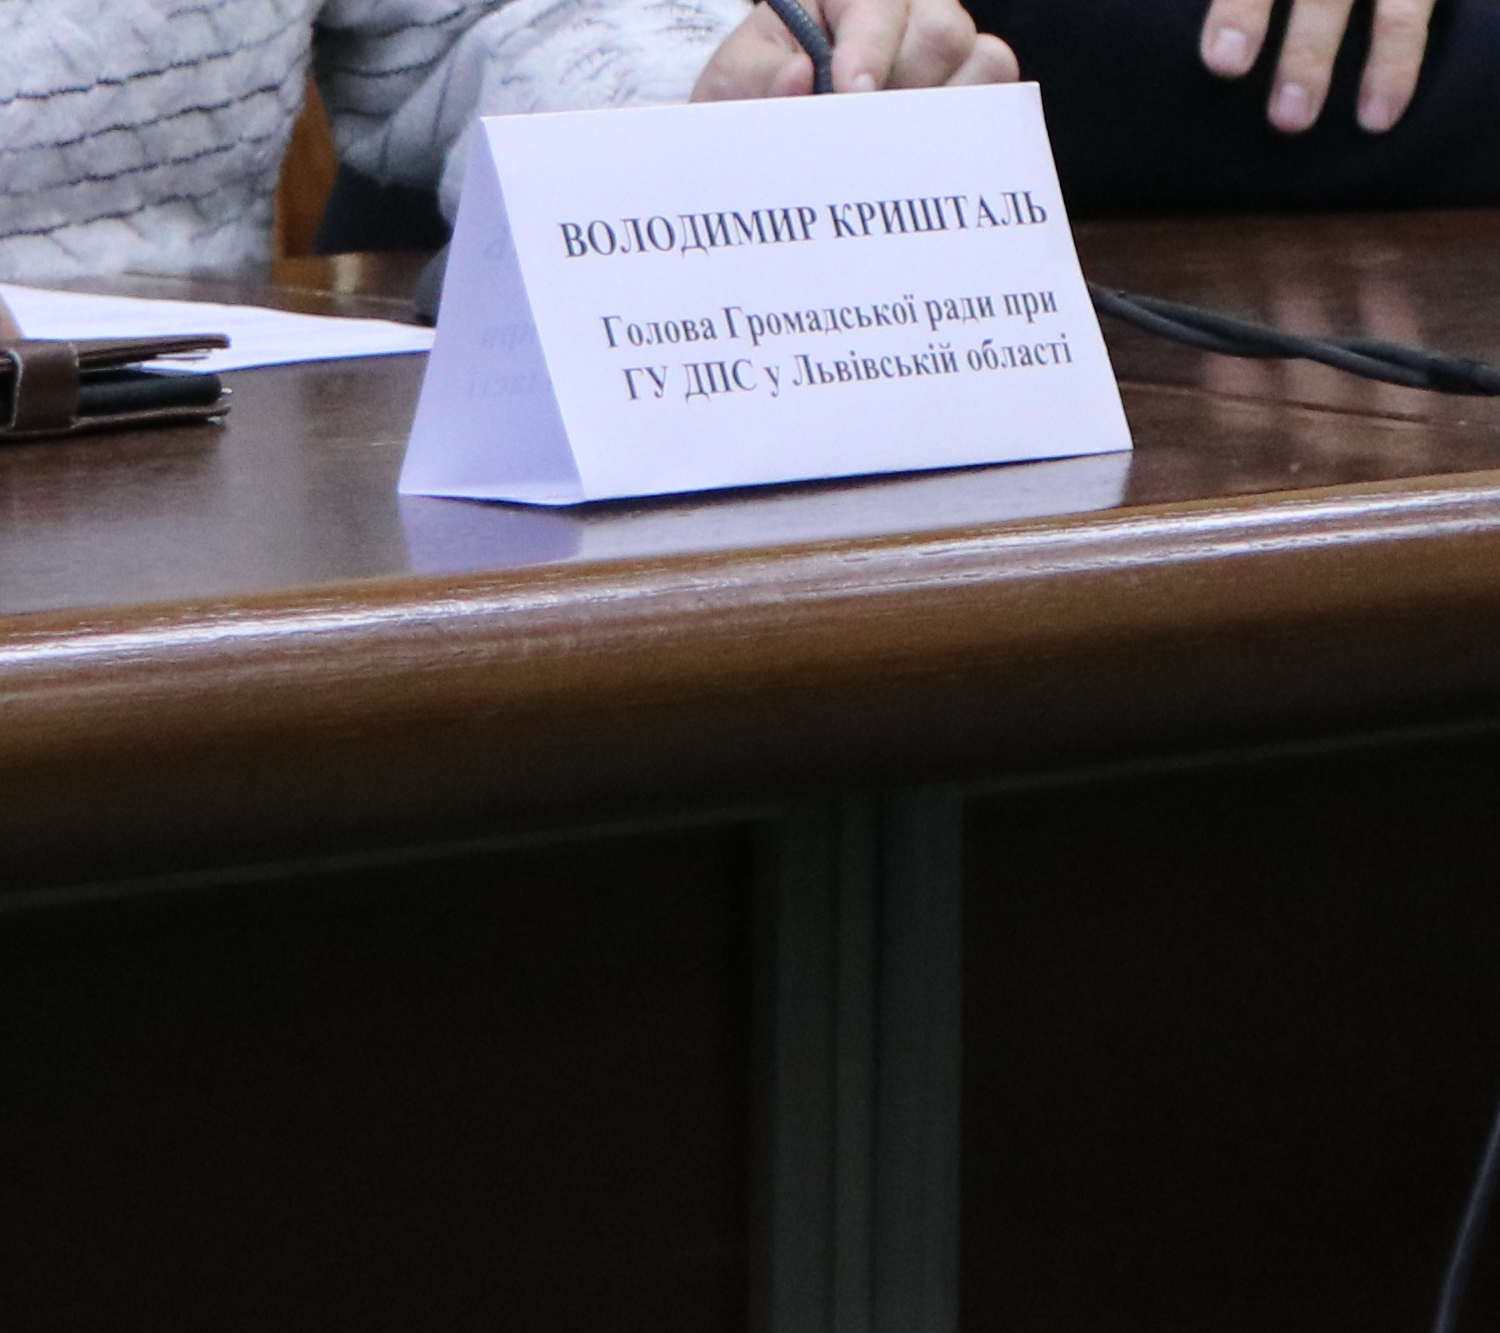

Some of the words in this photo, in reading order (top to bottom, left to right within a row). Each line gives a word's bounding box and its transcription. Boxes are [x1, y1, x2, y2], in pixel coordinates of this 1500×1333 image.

[560, 207, 817, 258] ВОЛОДИМИР
[829, 191, 1048, 239] КРИШТАЛЬ
[601, 315, 717, 349] Голова
[723, 297, 920, 346] Громадської
[925, 295, 996, 332] ради
[1003, 290, 1059, 325] при
[623, 362, 669, 401] ГУ
[683, 358, 756, 402] ДПС
[765, 366, 781, 398] у
[791, 344, 960, 386] Львівській
[967, 333, 1074, 370] області
